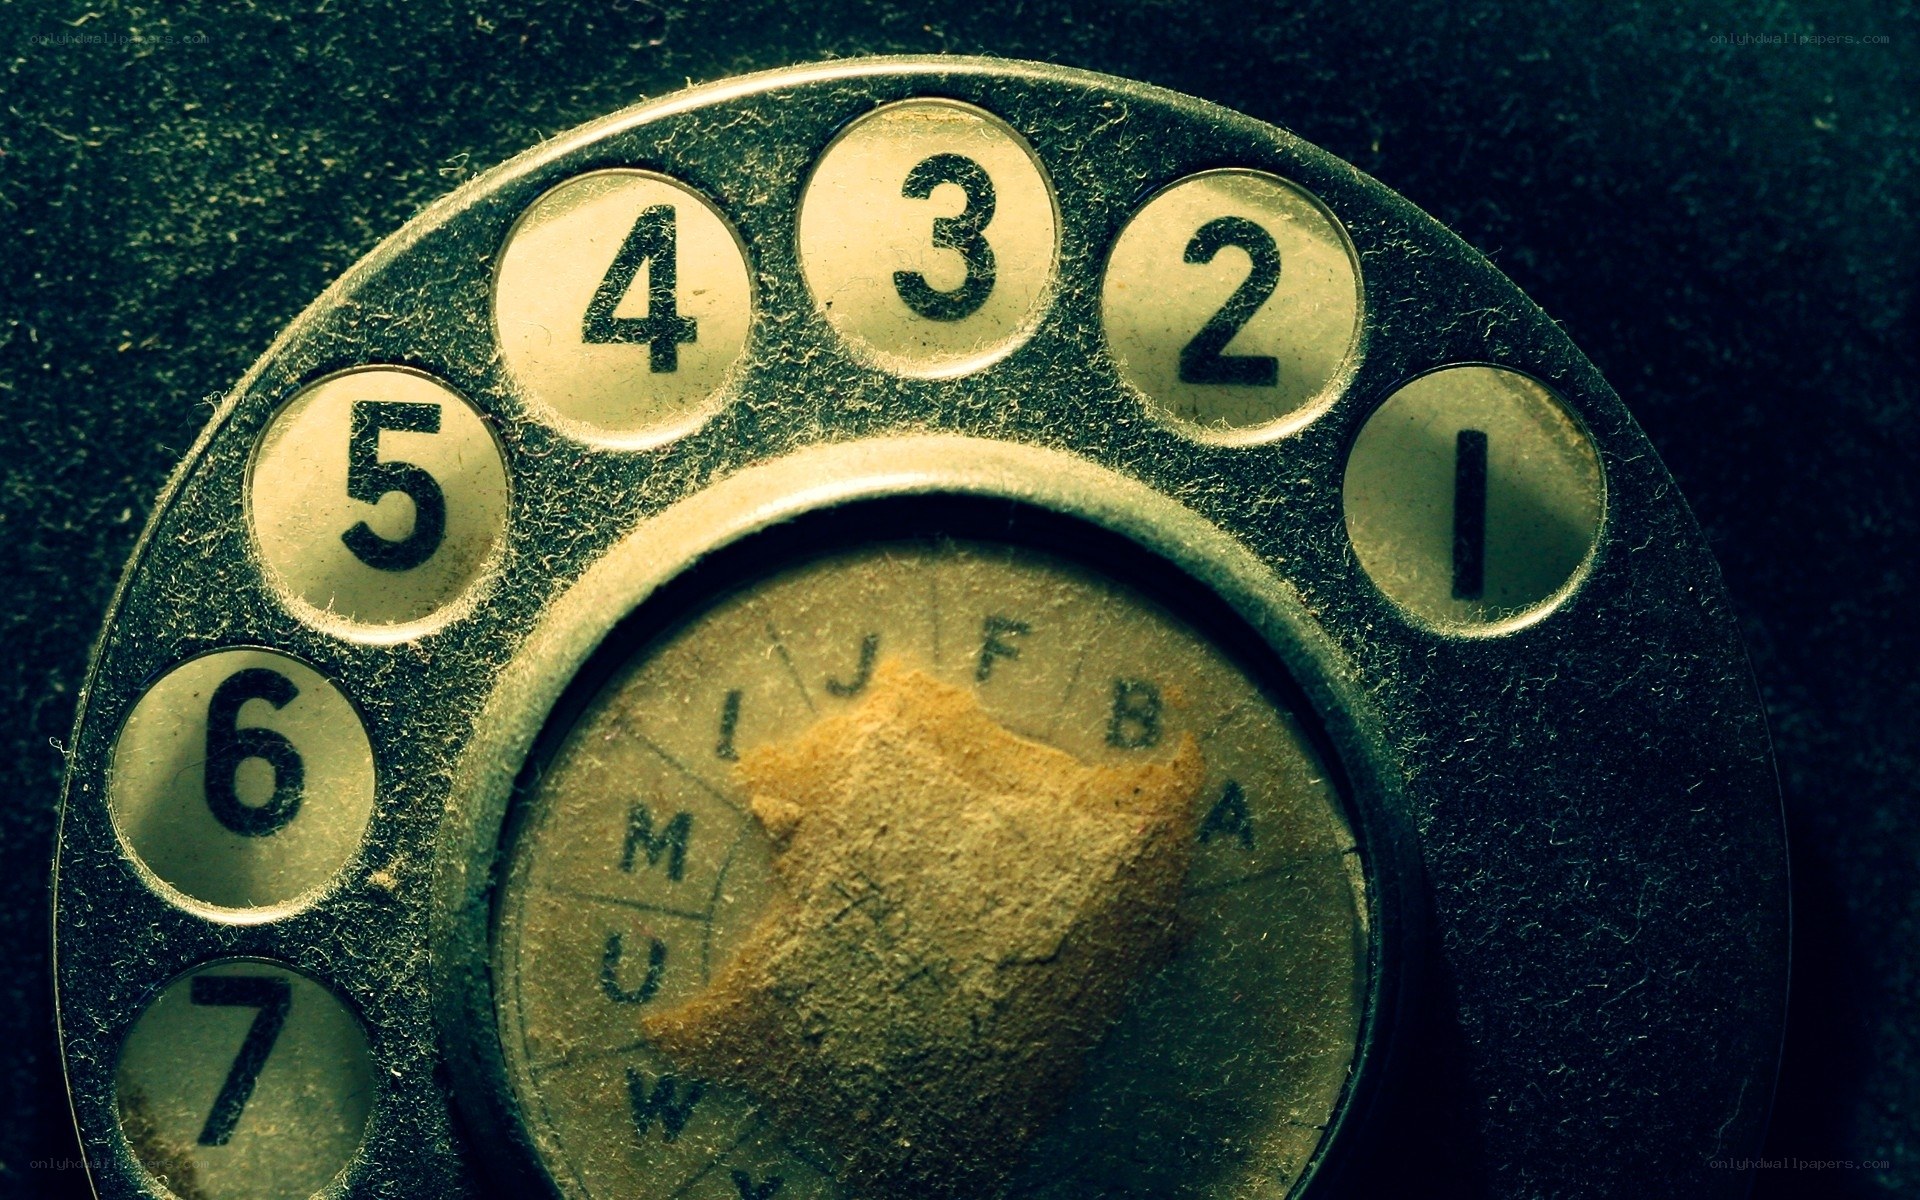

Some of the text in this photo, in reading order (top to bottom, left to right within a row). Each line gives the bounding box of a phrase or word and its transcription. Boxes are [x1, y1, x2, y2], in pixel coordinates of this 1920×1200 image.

[581, 204, 697, 373] 4
[893, 152, 997, 321] 3
[1178, 215, 1281, 387] 2
[340, 400, 447, 572] 5
[1451, 429, 1488, 601] 1
[827, 634, 879, 697] J
[976, 617, 1030, 680] F
[203, 668, 304, 838] 6
[1106, 680, 1162, 749] B
[620, 803, 694, 881] M
[1199, 781, 1254, 849] A
[601, 934, 667, 1002] U
[190, 977, 292, 1146] 7
[628, 1068, 706, 1142] W
